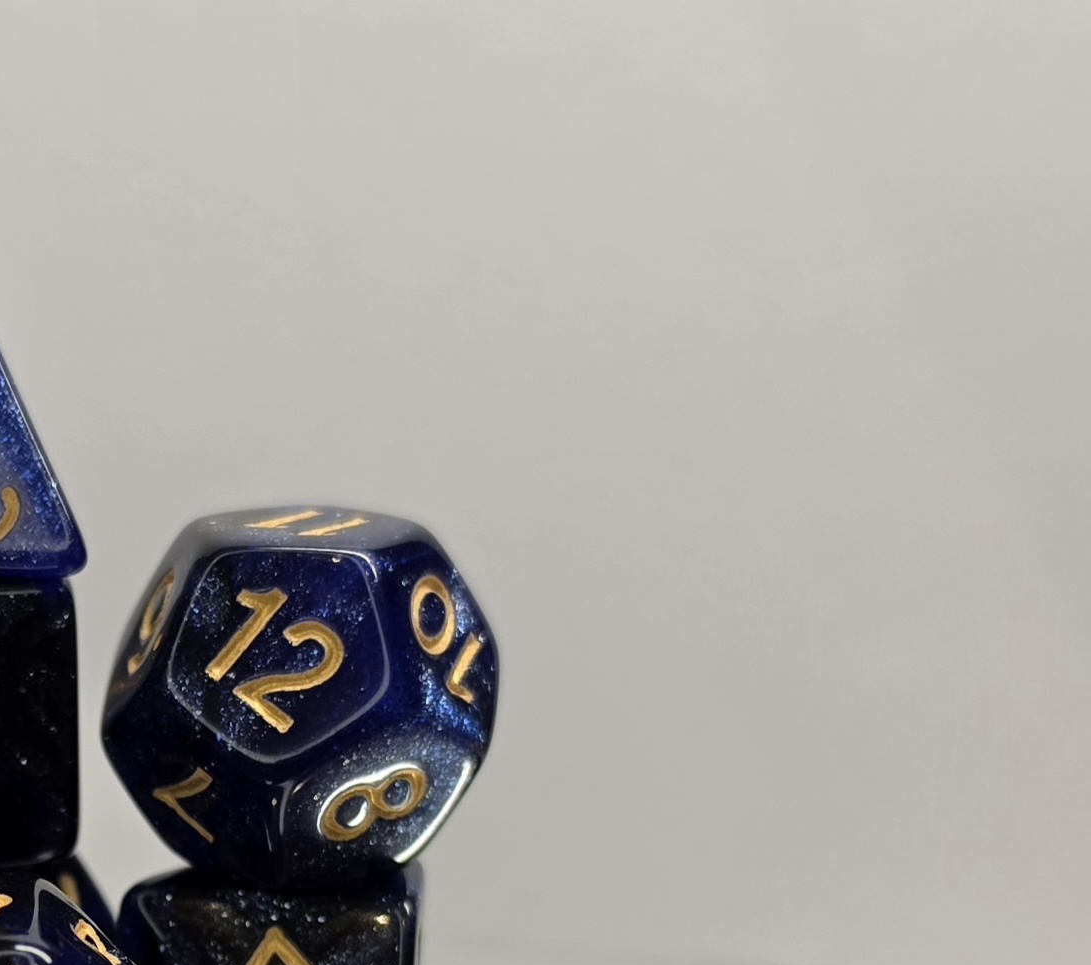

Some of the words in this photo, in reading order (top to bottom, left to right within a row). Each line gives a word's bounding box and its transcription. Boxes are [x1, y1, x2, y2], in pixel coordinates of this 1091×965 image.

[243, 510, 371, 538] 11
[205, 586, 346, 735] 12
[410, 575, 483, 705] 10
[152, 766, 214, 844] 7
[319, 766, 428, 842] 8
